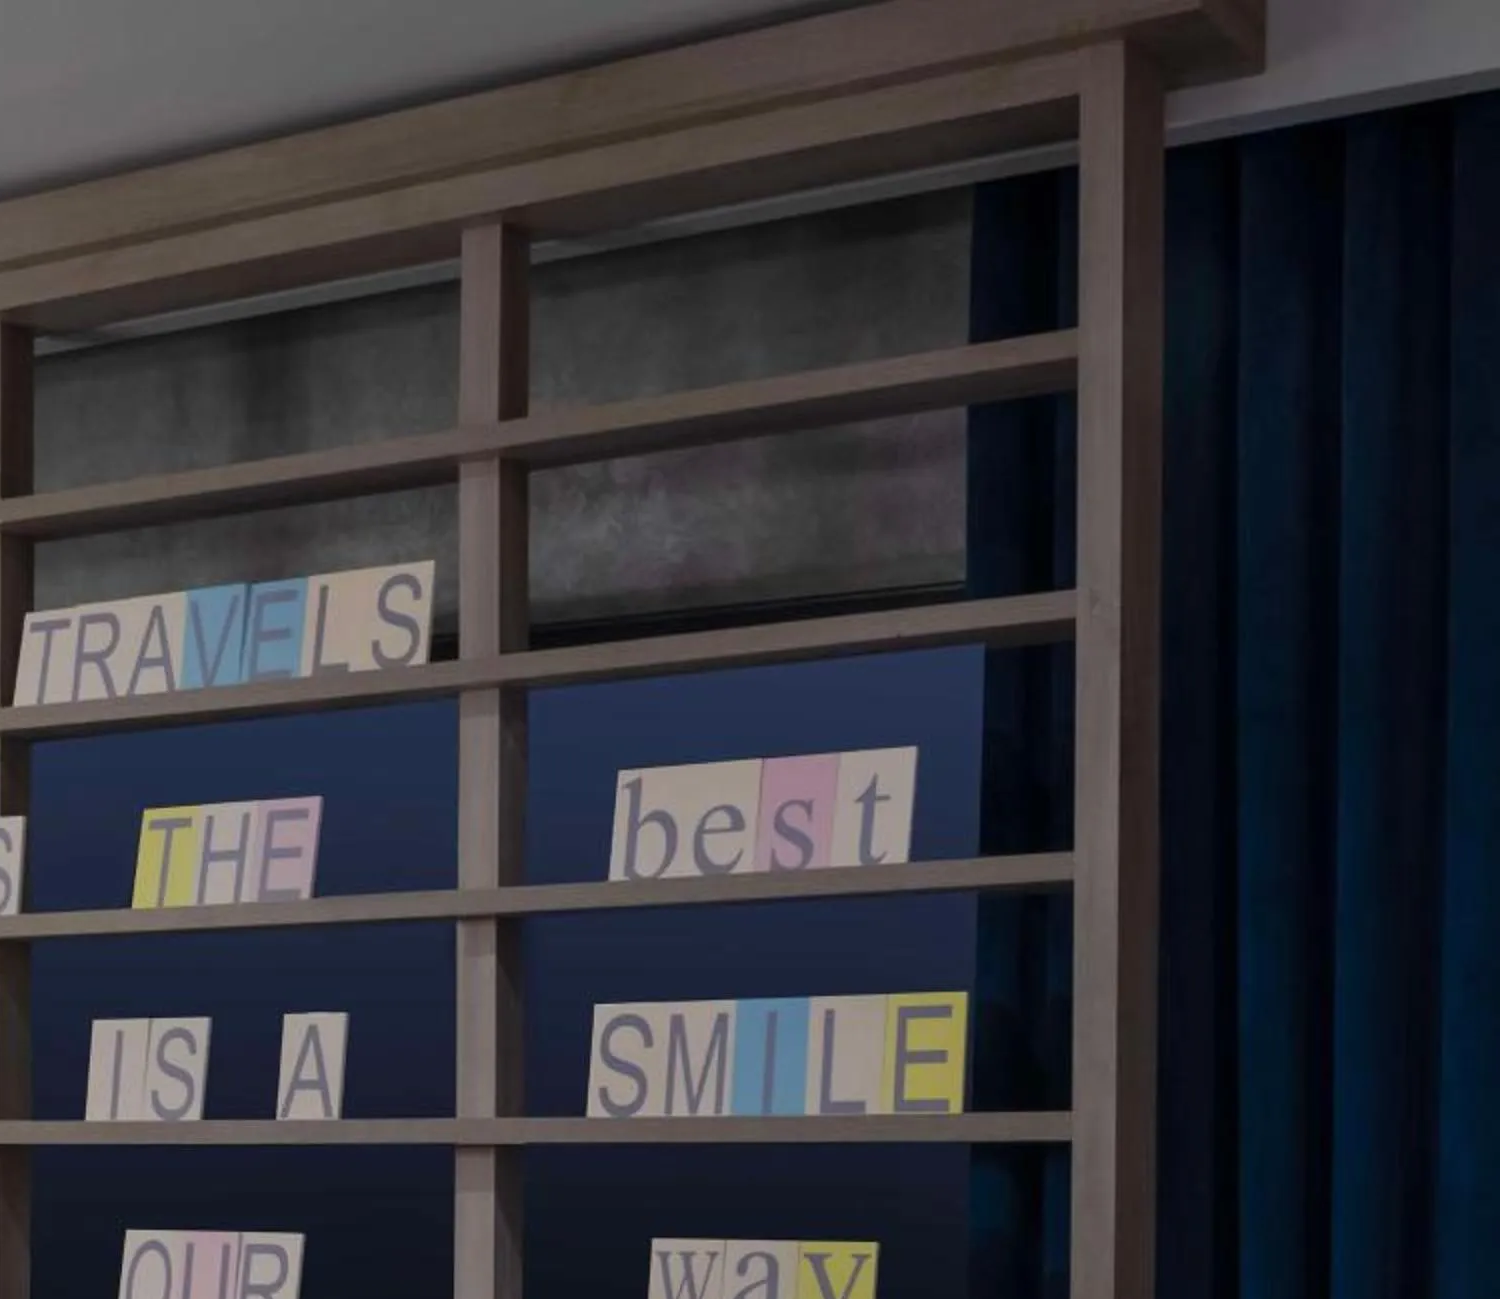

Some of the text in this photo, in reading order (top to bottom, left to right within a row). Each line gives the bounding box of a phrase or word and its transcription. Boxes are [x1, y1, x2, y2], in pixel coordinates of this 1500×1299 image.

[28, 573, 422, 705] TRAVELS
[146, 808, 311, 906] THE
[621, 773, 891, 880] best
[110, 1027, 196, 1120] IS
[281, 1024, 334, 1118] A
[597, 1003, 954, 1119] SMILE
